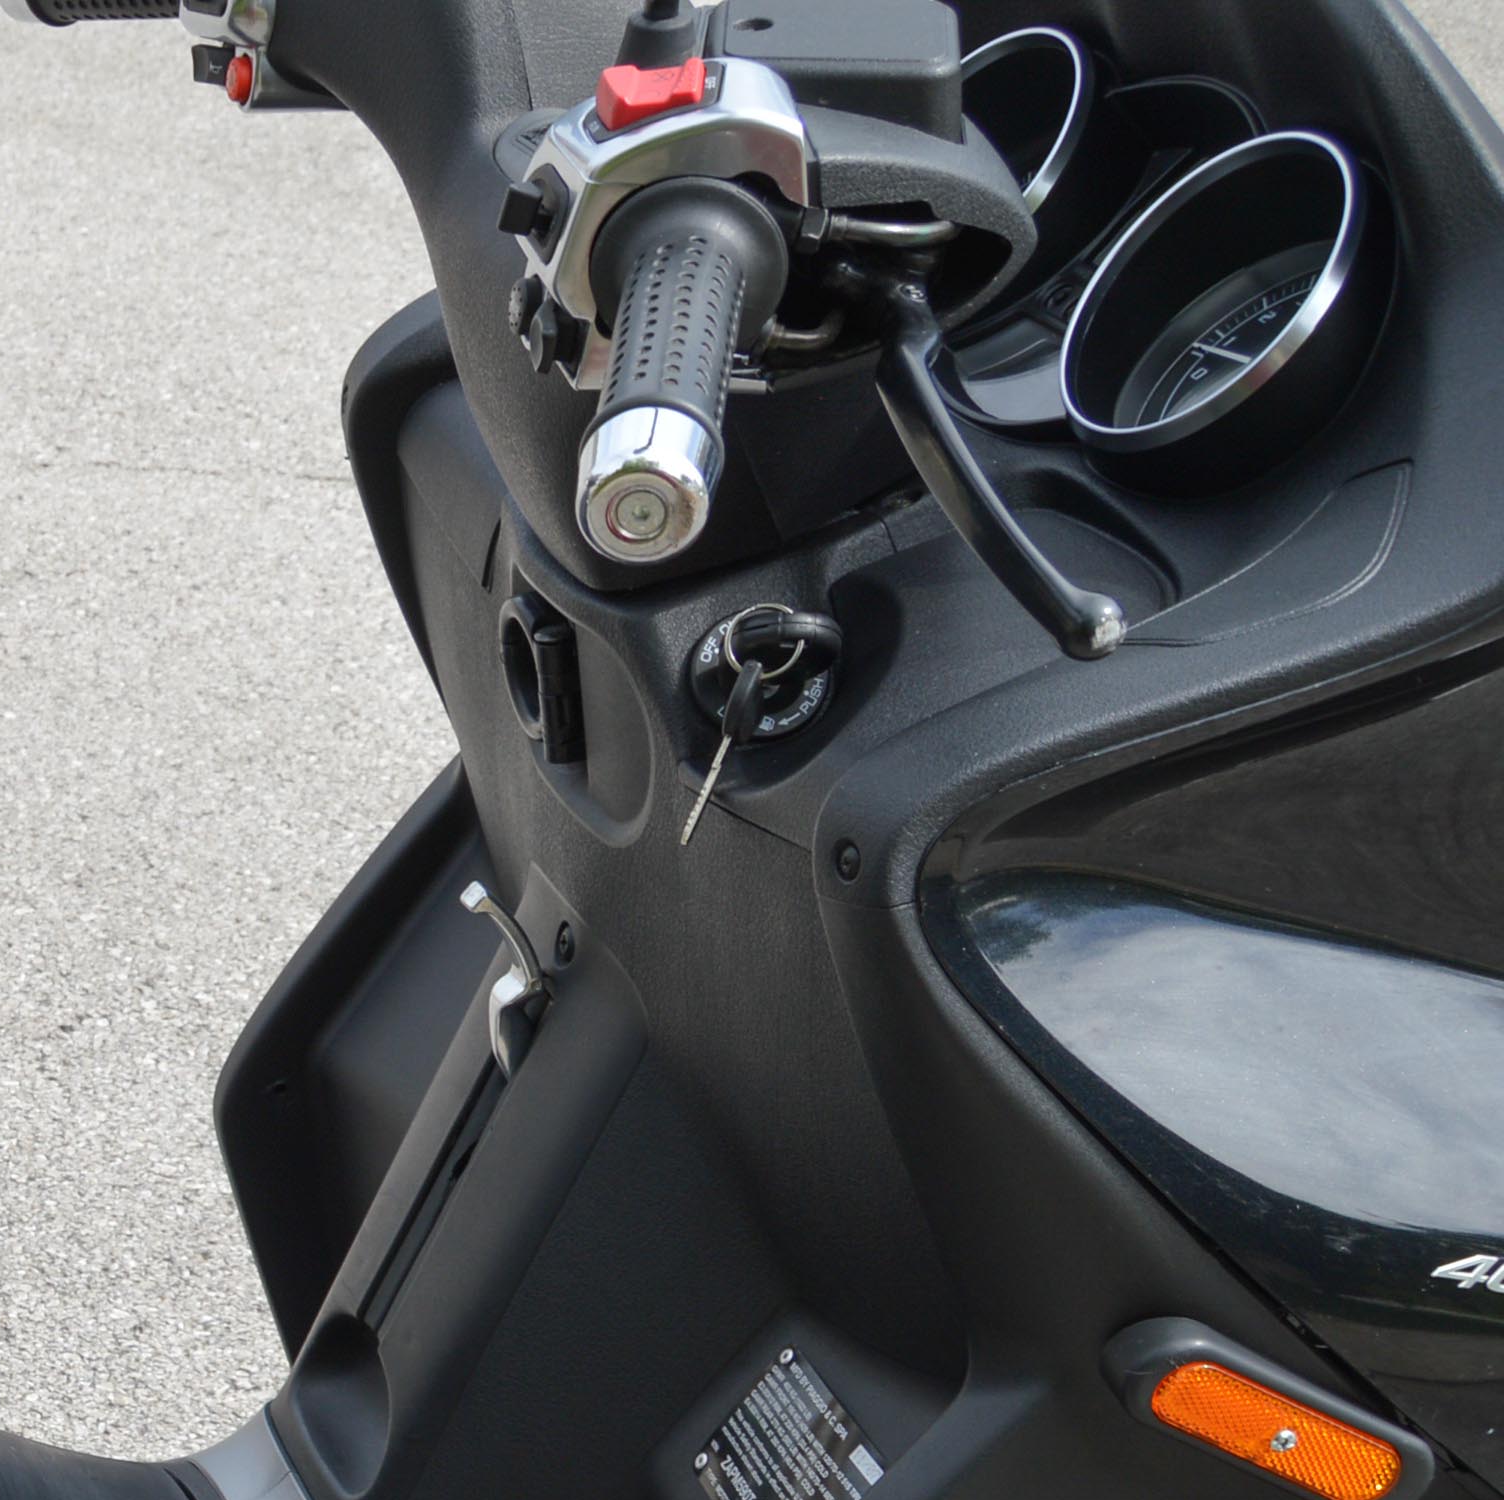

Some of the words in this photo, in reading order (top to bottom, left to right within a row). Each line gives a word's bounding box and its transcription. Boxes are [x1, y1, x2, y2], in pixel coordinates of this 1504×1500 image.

[700, 637, 717, 663] OFF
[799, 678, 824, 715] PUSH
[805, 1384, 828, 1413] PIAGGIO
[823, 1408, 831, 1419] &
[813, 1460, 829, 1480] COLD
[800, 1477, 815, 1497] COLD
